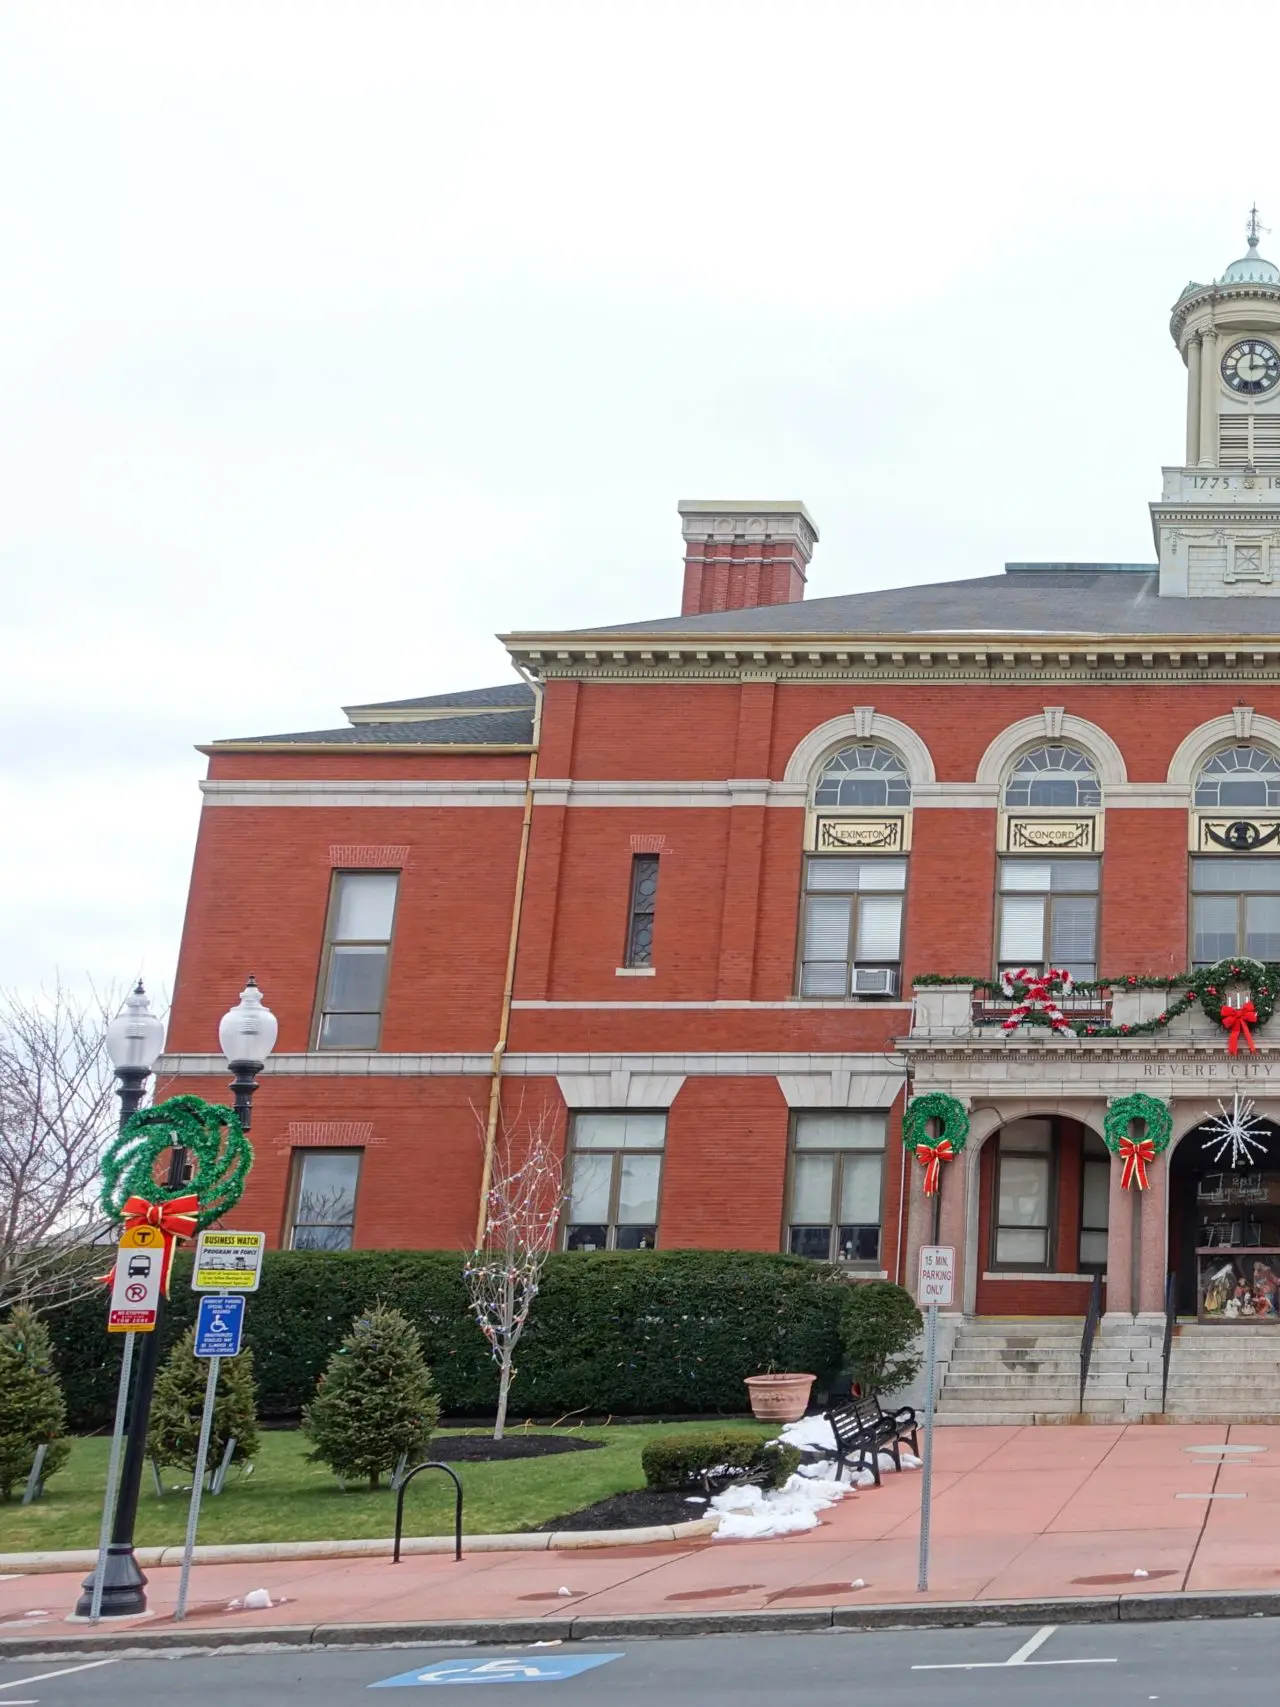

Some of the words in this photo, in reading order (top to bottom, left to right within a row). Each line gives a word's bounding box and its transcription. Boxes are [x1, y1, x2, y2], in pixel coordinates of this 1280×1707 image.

[1193, 476, 1230, 490] 1775
[835, 830, 885, 839] LEXINGTON
[1028, 830, 1075, 839] CONCORD
[1143, 1064, 1218, 1076] REVERE
[1230, 1064, 1273, 1076] CITY
[204, 1235, 235, 1245] BUSINESS
[237, 1236, 259, 1245] WATCH
[925, 1256, 933, 1266] 15
[922, 1269, 952, 1281] PARKING
[926, 1284, 944, 1295] ONLY
